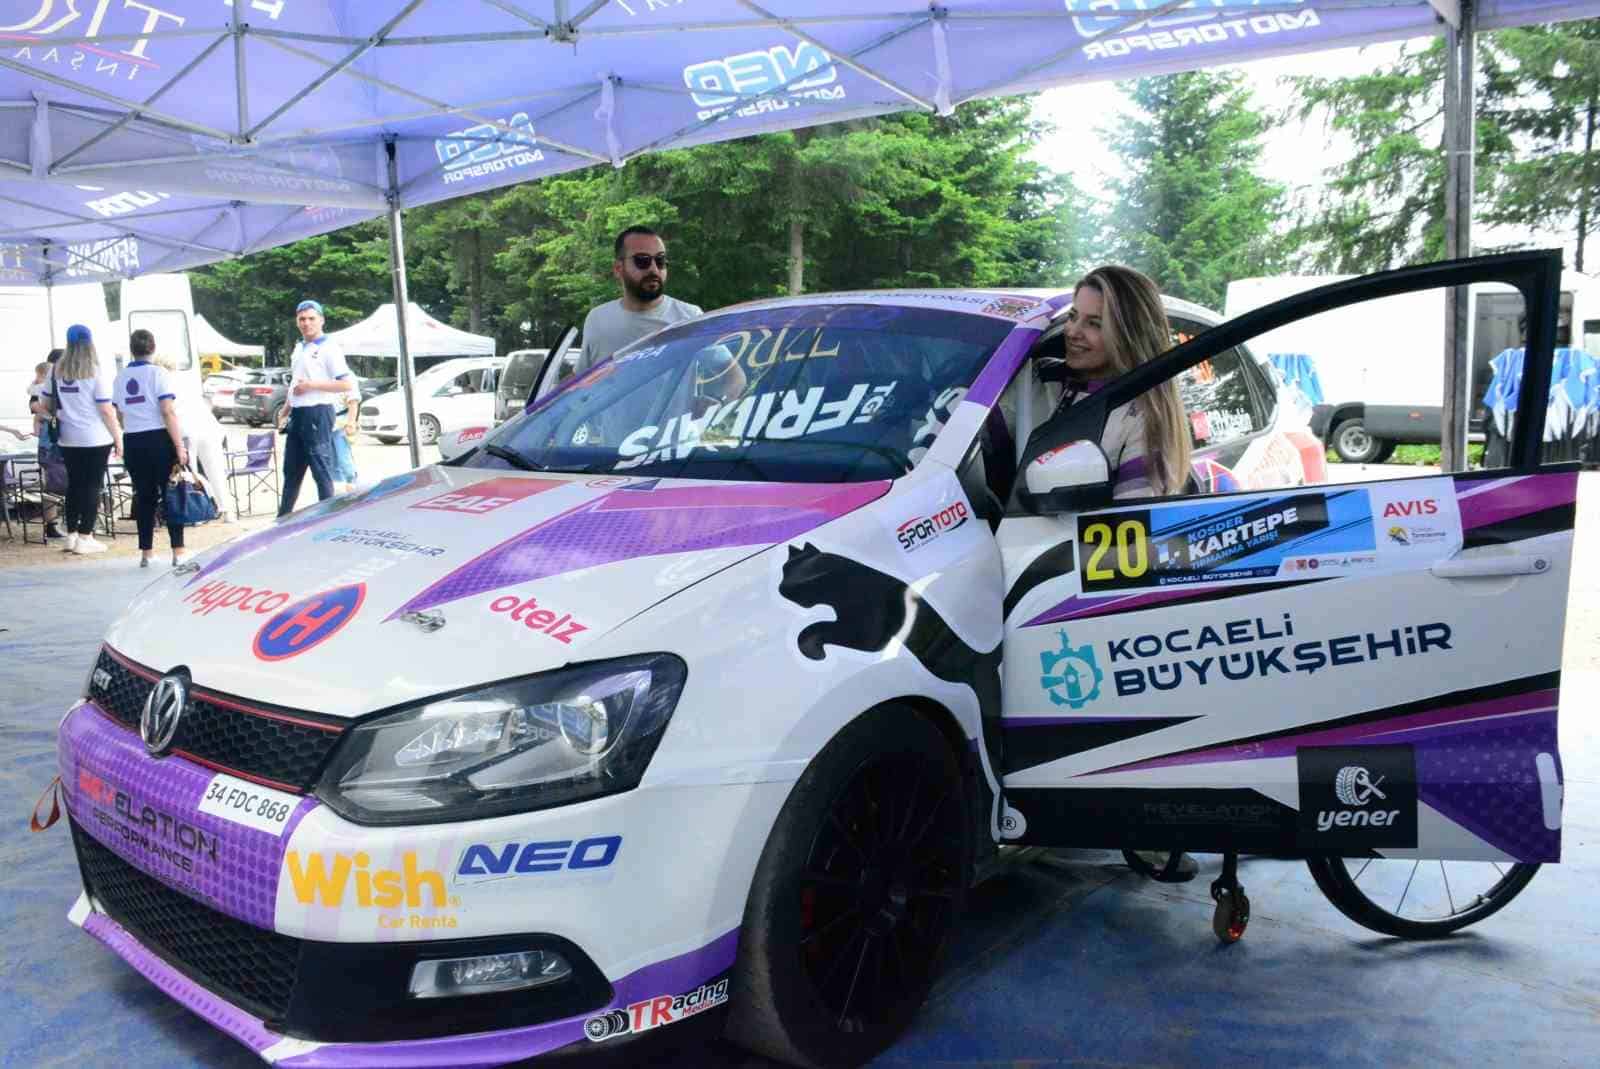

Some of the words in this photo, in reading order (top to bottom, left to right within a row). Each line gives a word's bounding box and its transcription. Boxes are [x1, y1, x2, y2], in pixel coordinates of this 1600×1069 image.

[1384, 500, 1438, 517] AVIS
[1188, 516, 1244, 543] KOSDER
[1188, 508, 1298, 562] KARTEPE
[1084, 520, 1148, 581] 20
[183, 581, 290, 616] Hypco
[489, 595, 592, 644] otelz
[206, 783, 225, 804] 34
[226, 788, 255, 813] FDC
[256, 801, 290, 823] 868
[1317, 809, 1401, 831] yener
[94, 808, 193, 873] PERFORMANCE
[457, 835, 623, 875] NEO
[287, 849, 448, 908] Wish
[378, 914, 404, 928] Car
[628, 979, 729, 1030] TRacing
